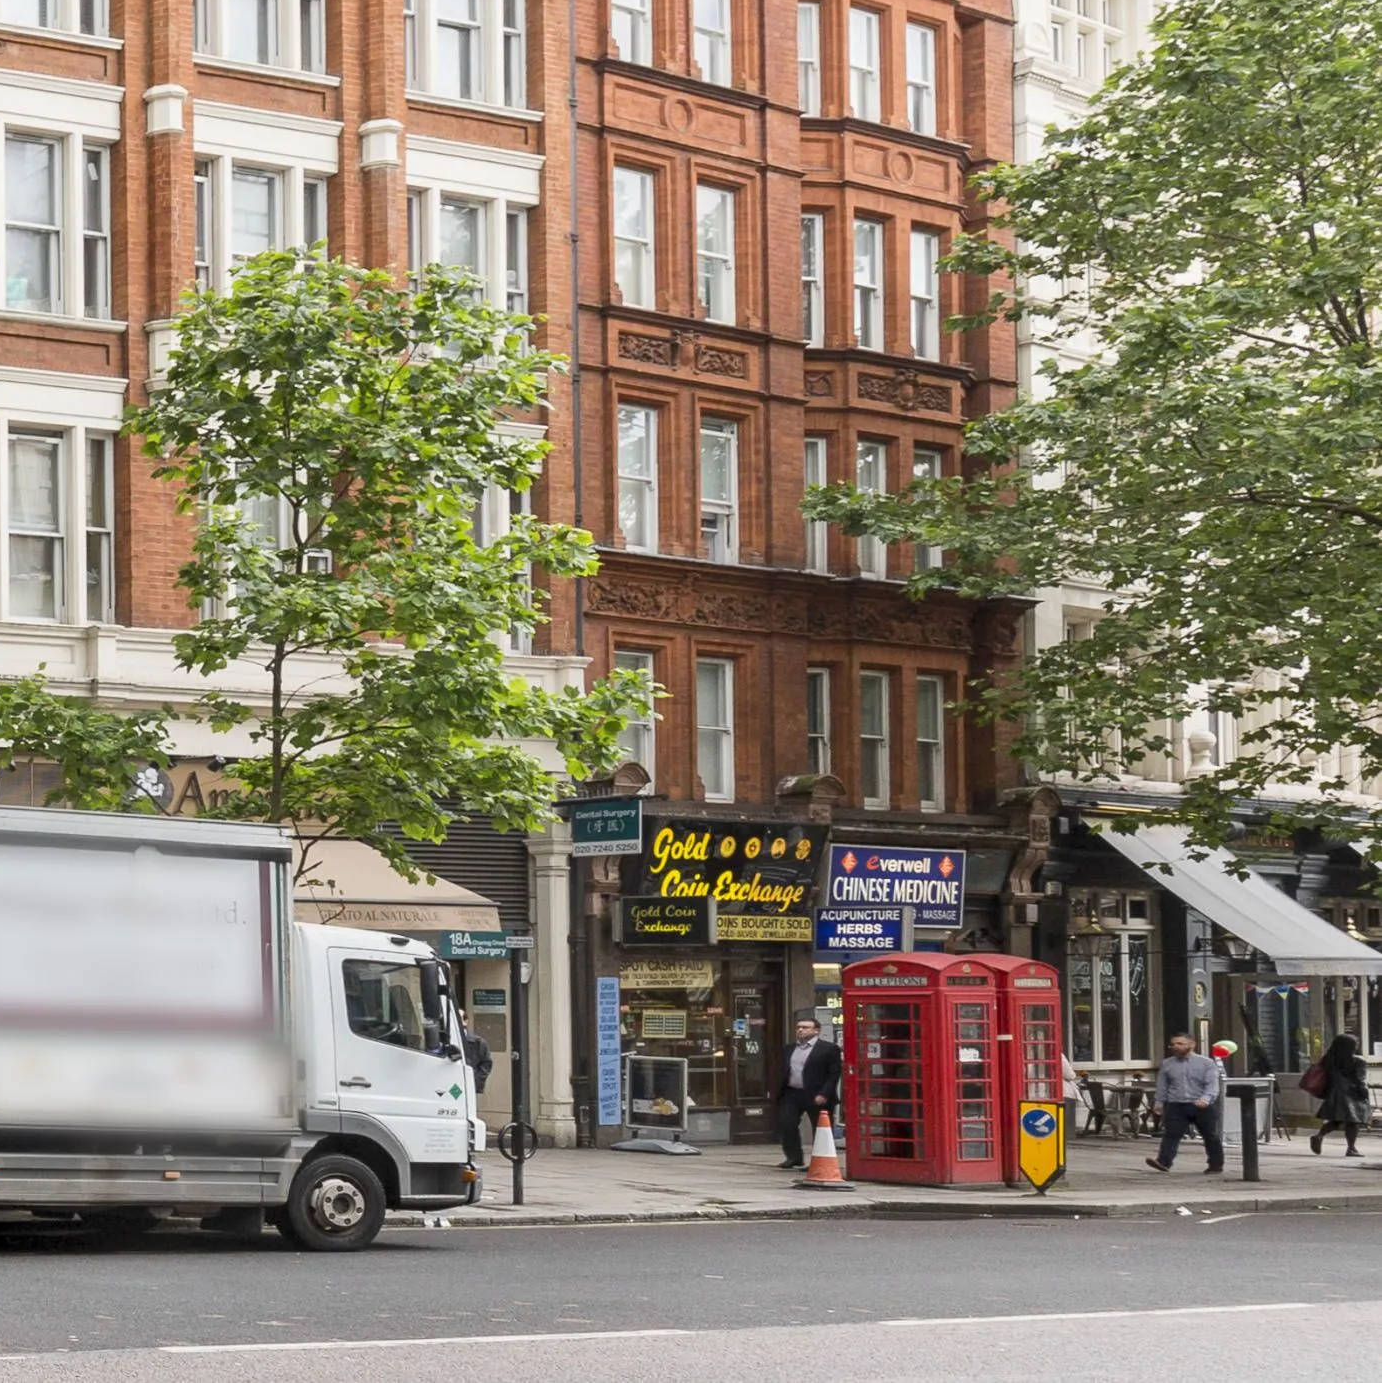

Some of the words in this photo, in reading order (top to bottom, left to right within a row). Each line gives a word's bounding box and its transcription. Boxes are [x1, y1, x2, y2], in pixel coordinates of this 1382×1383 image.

[576, 811, 602, 819] Dental
[603, 809, 637, 818] Surgery
[650, 827, 711, 874] Gold
[867, 855, 931, 874] everwell
[661, 869, 710, 897] Coin
[713, 870, 804, 912] Exchange
[833, 876, 890, 903] CHINESE
[893, 878, 960, 905] MEDICINE
[364, 910, 379, 922] AL
[381, 909, 440, 923] NATURALE
[631, 905, 660, 923] Gold
[665, 904, 696, 917] Coin
[820, 909, 900, 921] ACUPUNCTURE
[923, 910, 957, 920] MASSAGE
[636, 921, 691, 935] Exchange
[716, 917, 738, 929] OINS
[741, 917, 780, 929] BOUGHT
[786, 919, 811, 930] SOLD
[837, 923, 883, 935] HERBS
[449, 932, 472, 946] 18A
[828, 937, 894, 948] MASSAGE
[451, 946, 476, 955] Dental
[477, 946, 507, 957] Surgery
[647, 960, 675, 972] CASH
